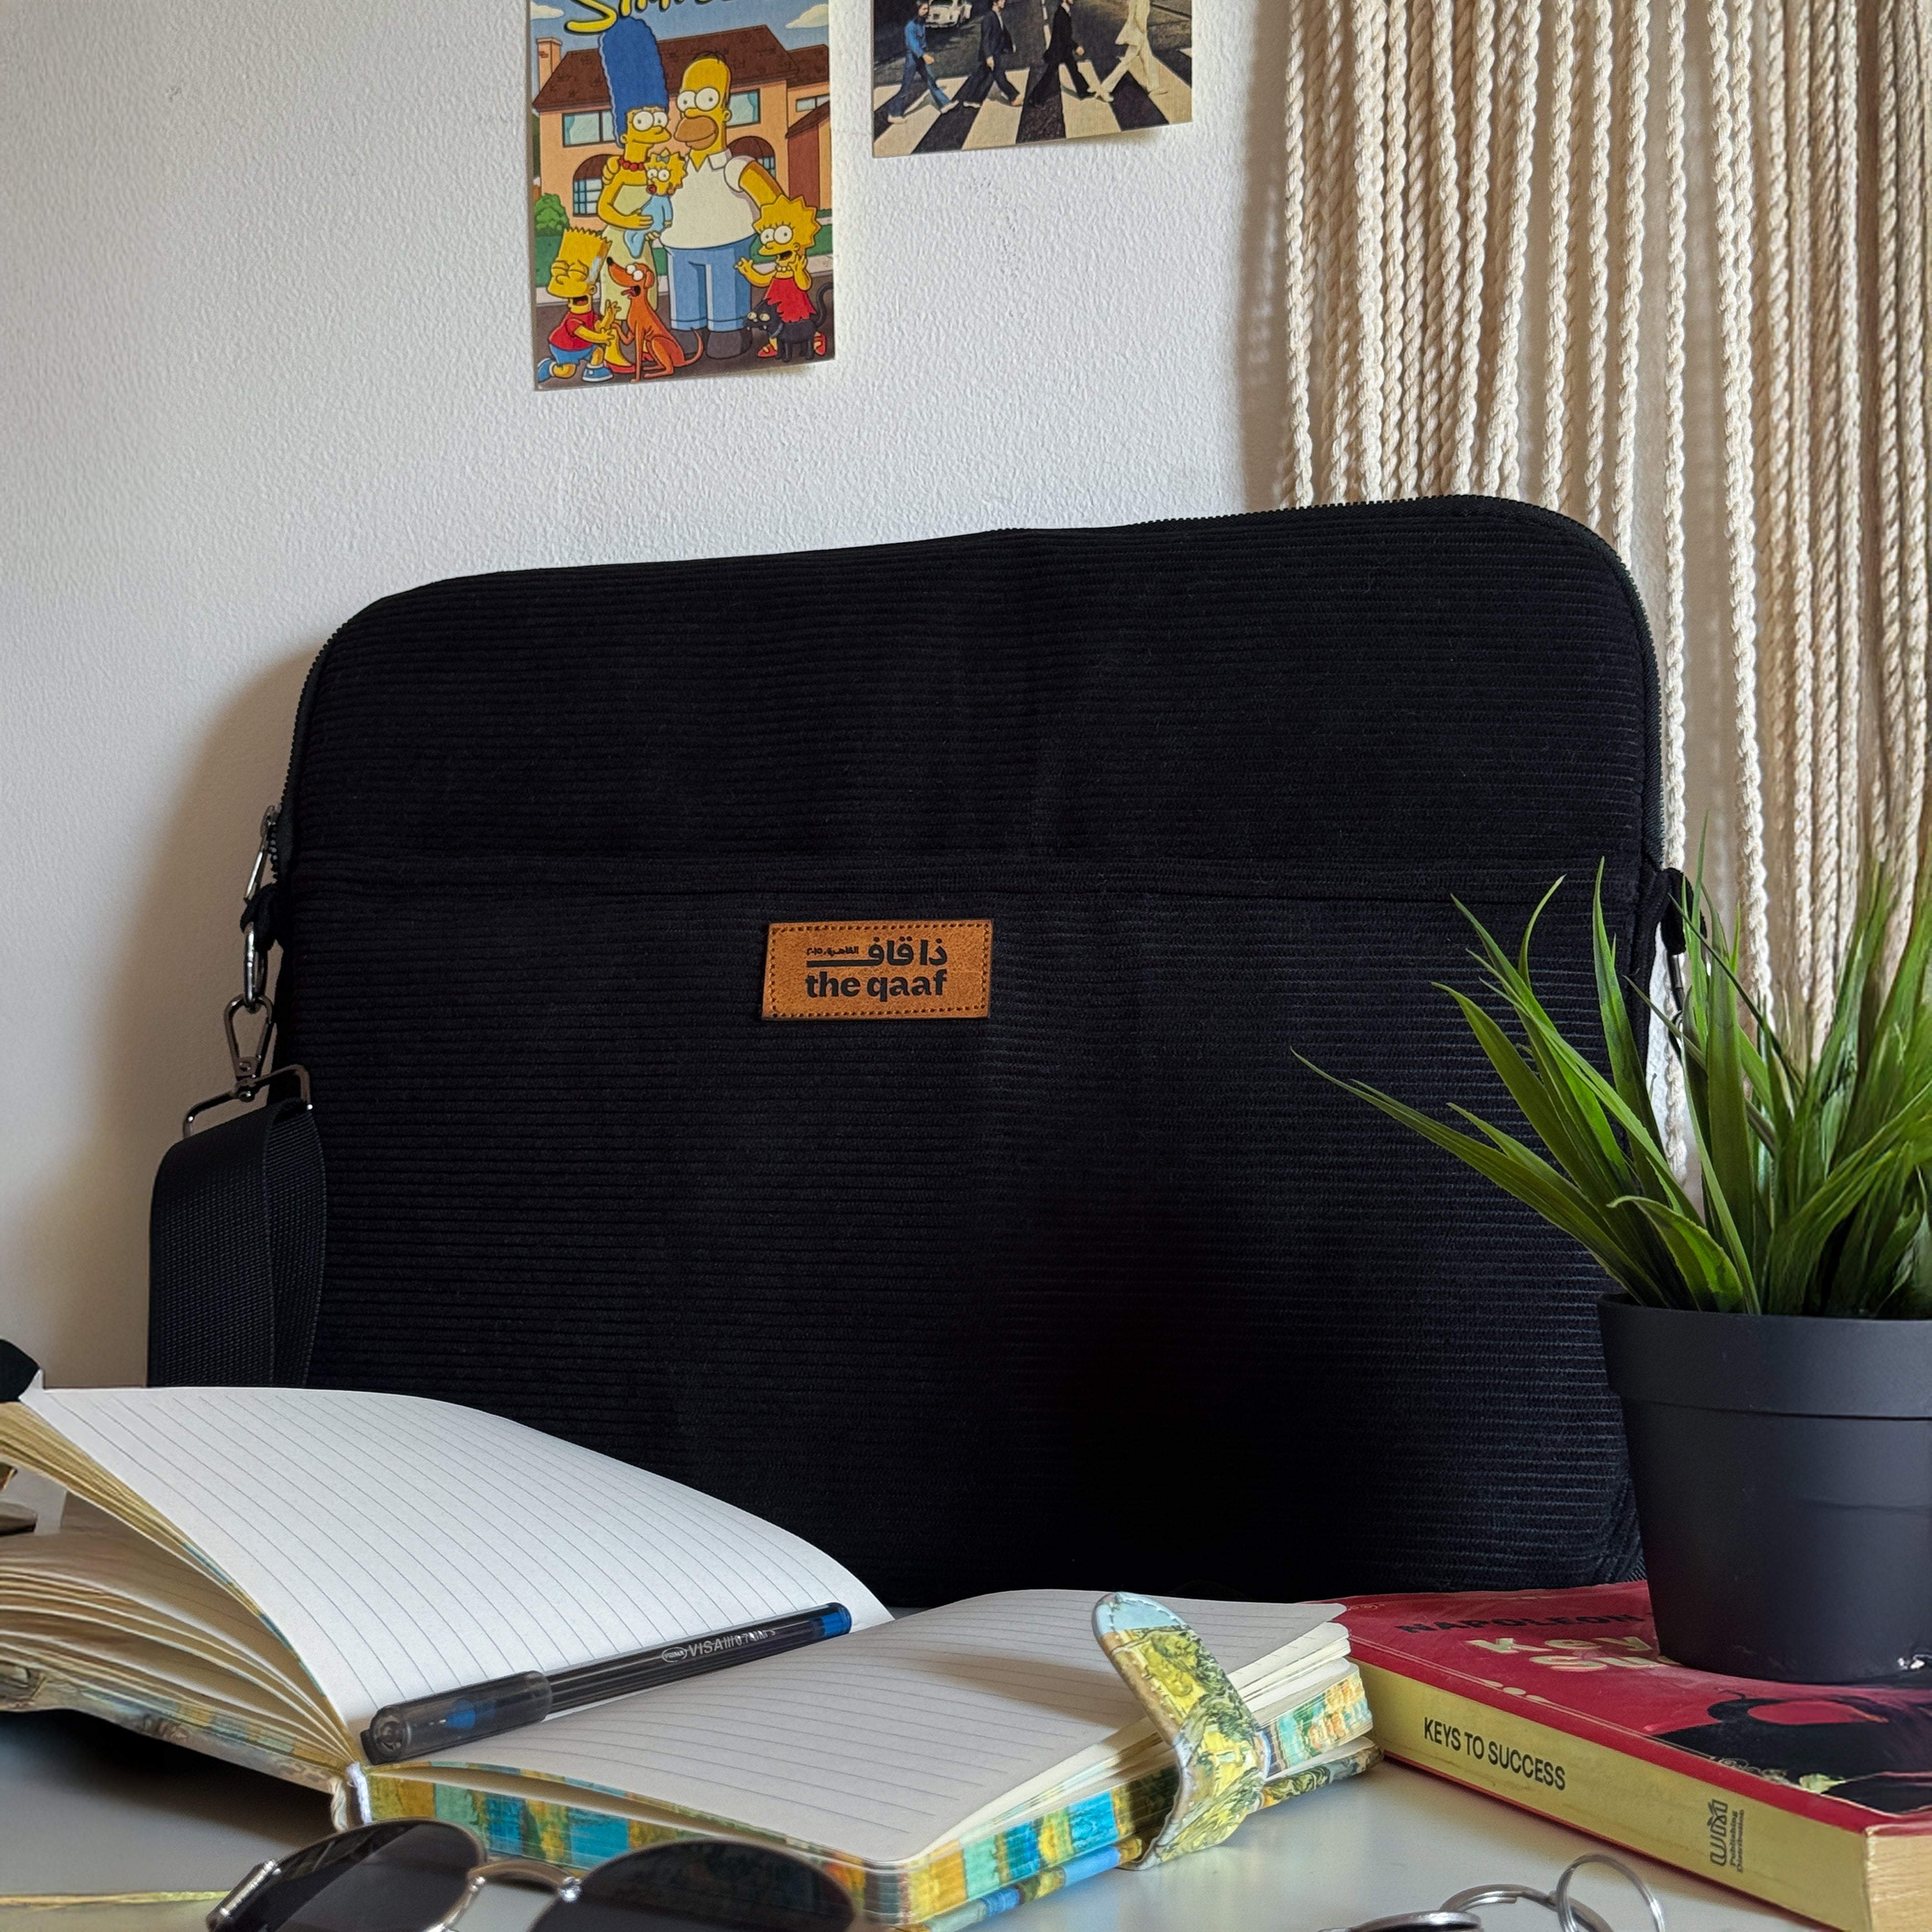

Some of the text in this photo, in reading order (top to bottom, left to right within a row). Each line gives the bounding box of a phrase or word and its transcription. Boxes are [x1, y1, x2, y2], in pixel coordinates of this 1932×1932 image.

[806, 937, 948, 967] ذا قاف
[805, 969, 948, 1002] the qaaf
[1395, 1614, 1645, 1633] NAPOLEON
[1466, 1636, 1653, 1654] Key
[1424, 1717, 1565, 1790] KEYS TO SUCCESS
